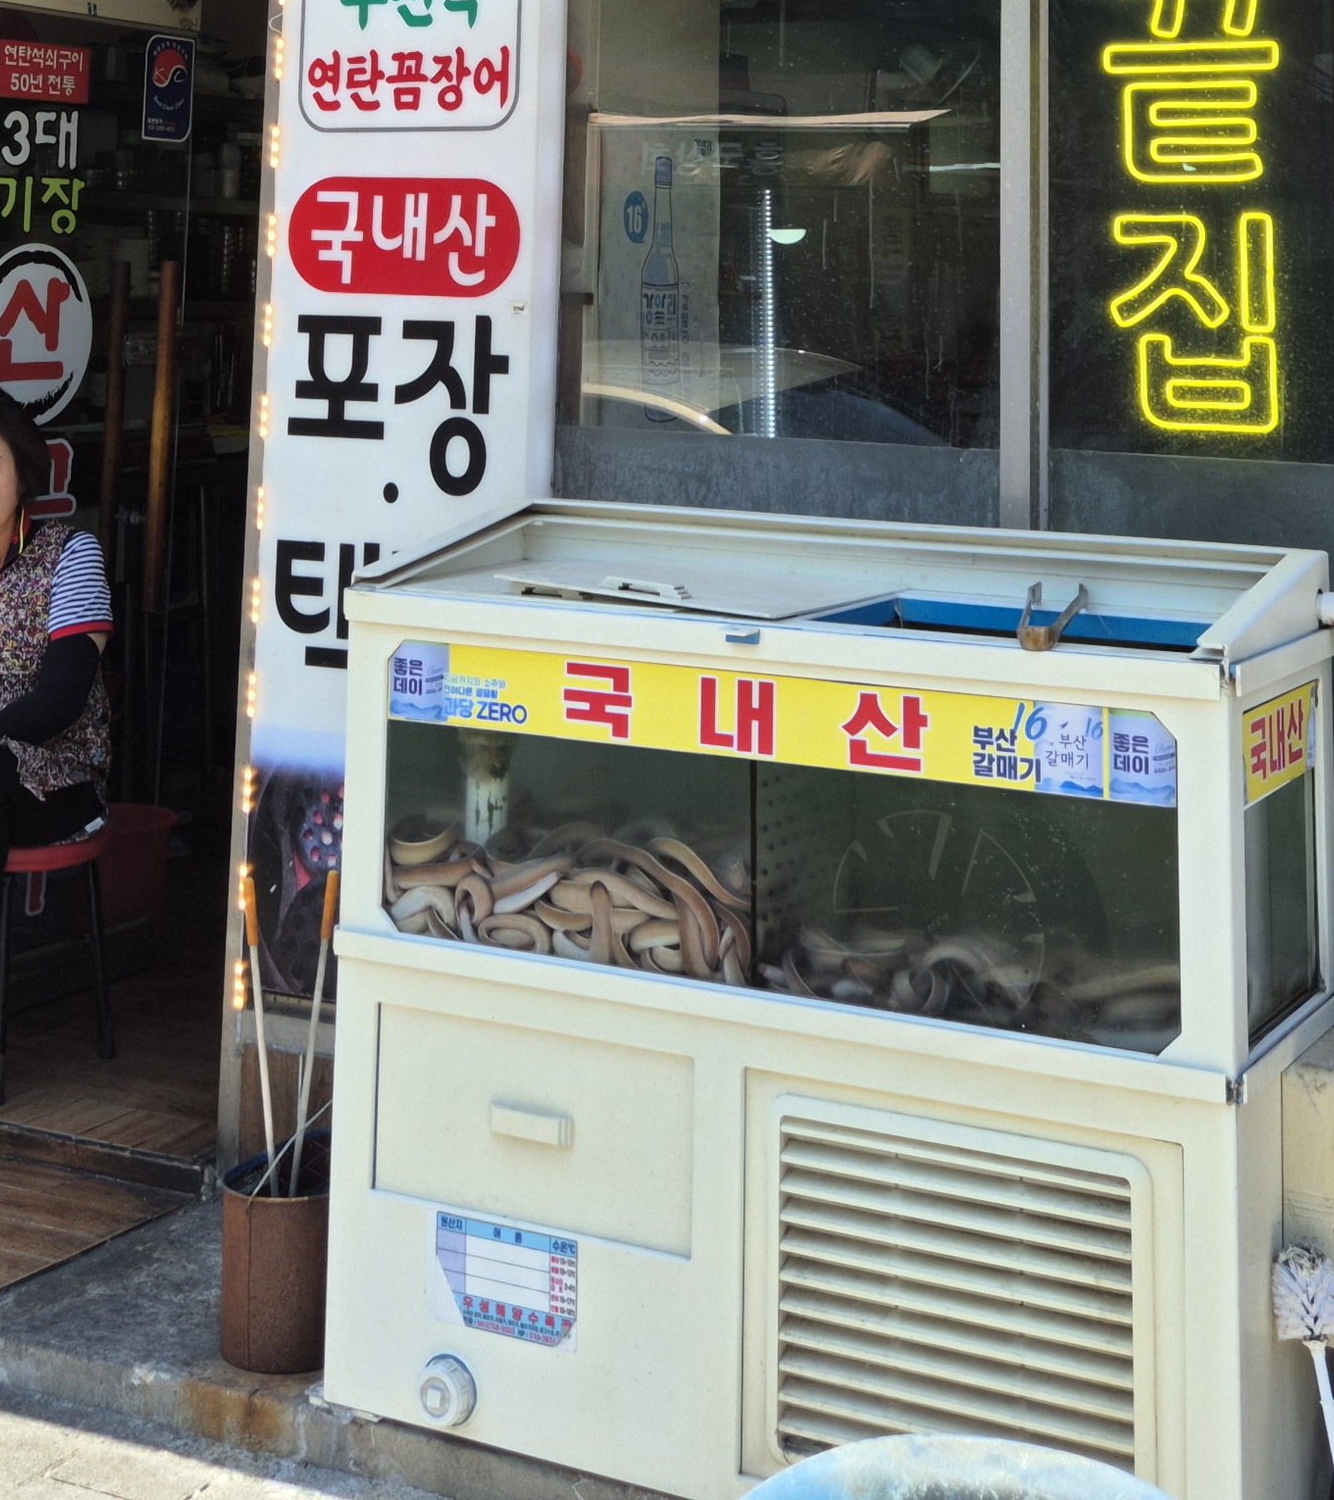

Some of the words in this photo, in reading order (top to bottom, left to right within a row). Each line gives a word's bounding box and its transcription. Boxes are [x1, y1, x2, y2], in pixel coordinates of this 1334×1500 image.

[4, 45, 84, 73] 연탄석쇠구이
[10, 73, 43, 94] 50년
[48, 75, 76, 96] 전통
[307, 45, 510, 112] 연탄꼼장어
[0, 110, 79, 170] 3대
[310, 190, 496, 287] 국내산
[286, 314, 510, 498] 포장
[394, 657, 423, 676] 좋은
[393, 676, 423, 696] 데이
[476, 700, 528, 724] ZERO
[561, 660, 931, 775] 국내산
[972, 725, 1017, 751] 부산
[1013, 701, 1048, 741] 16
[1250, 698, 1305, 780] 국내산
[1058, 734, 1087, 750] 부산
[1112, 731, 1149, 753] 좋은
[972, 751, 1042, 783] 갈매기
[1045, 749, 1090, 770] 갈매기
[1112, 753, 1149, 775] 데이
[440, 1216, 463, 1230] 원산지
